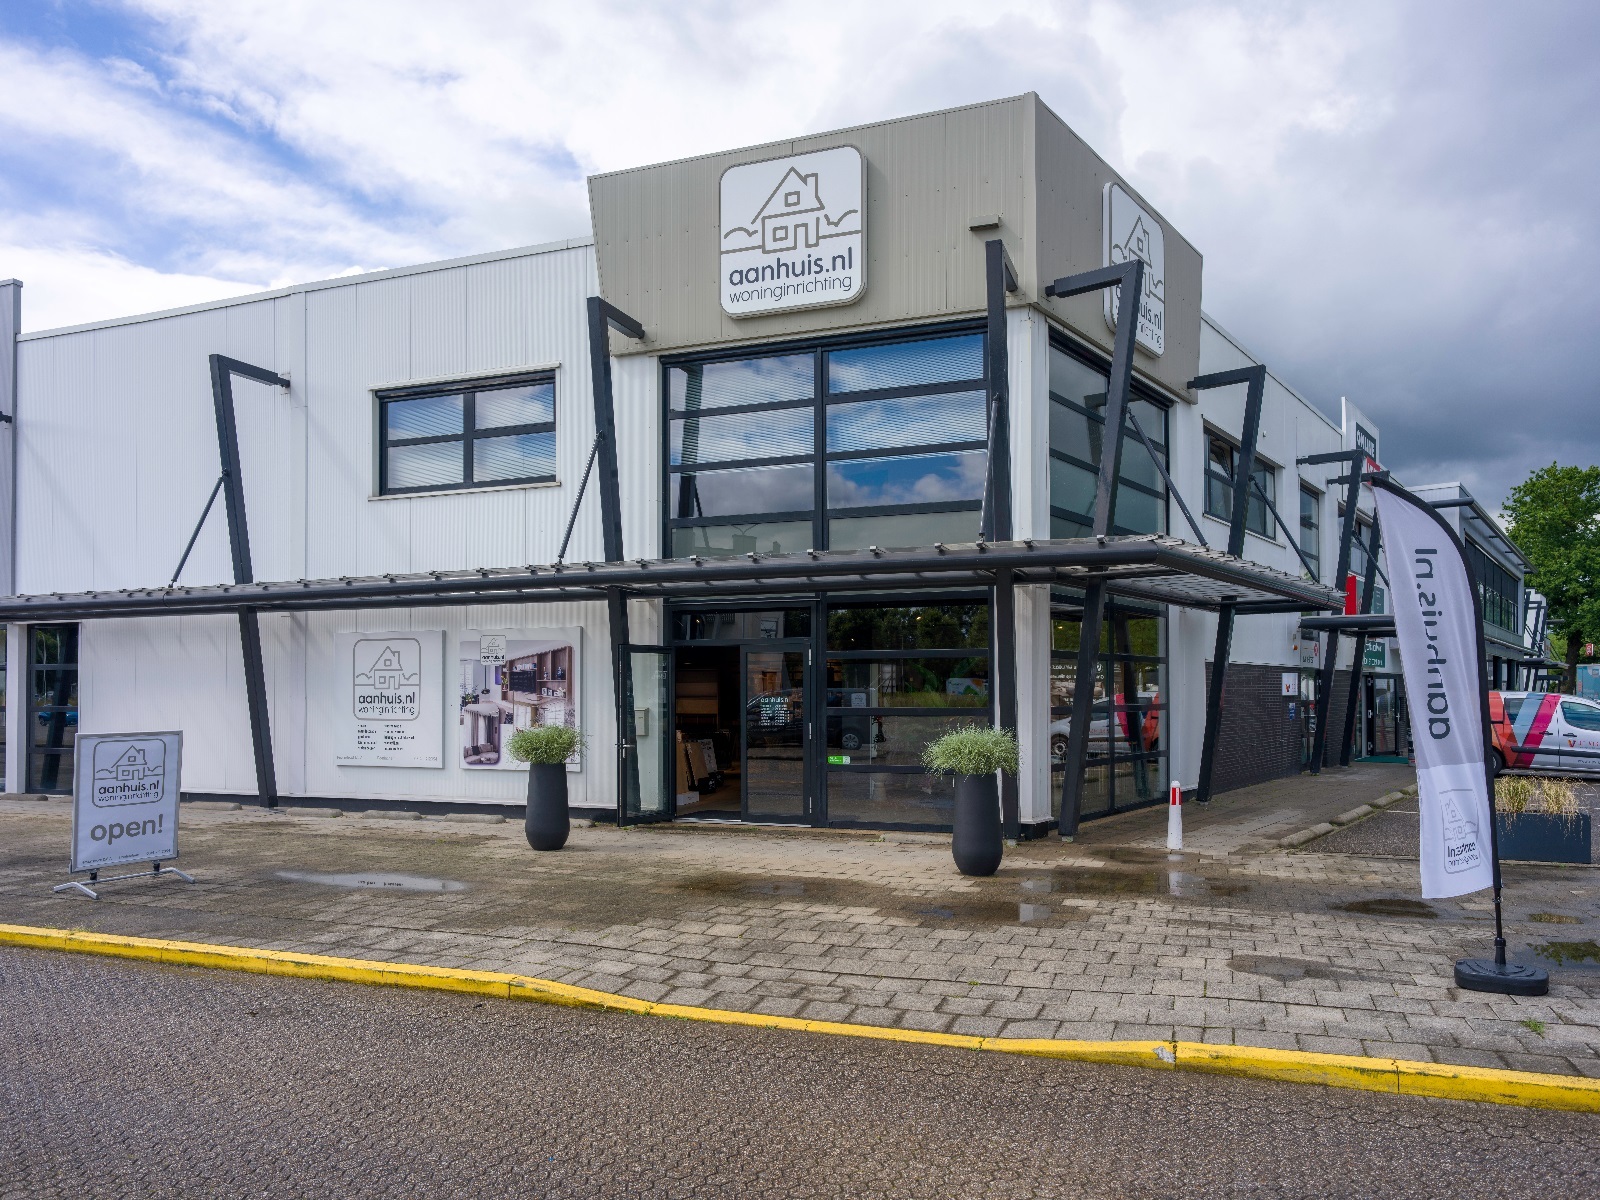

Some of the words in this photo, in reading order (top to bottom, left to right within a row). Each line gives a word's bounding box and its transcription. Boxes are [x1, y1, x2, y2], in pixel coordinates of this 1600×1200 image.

[729, 246, 853, 287] aanhuis.nl
[729, 276, 852, 303] woninginrichting
[358, 691, 416, 705] aanhuis.nl
[98, 780, 160, 794] aanhuis.nl
[90, 813, 164, 846] open!
